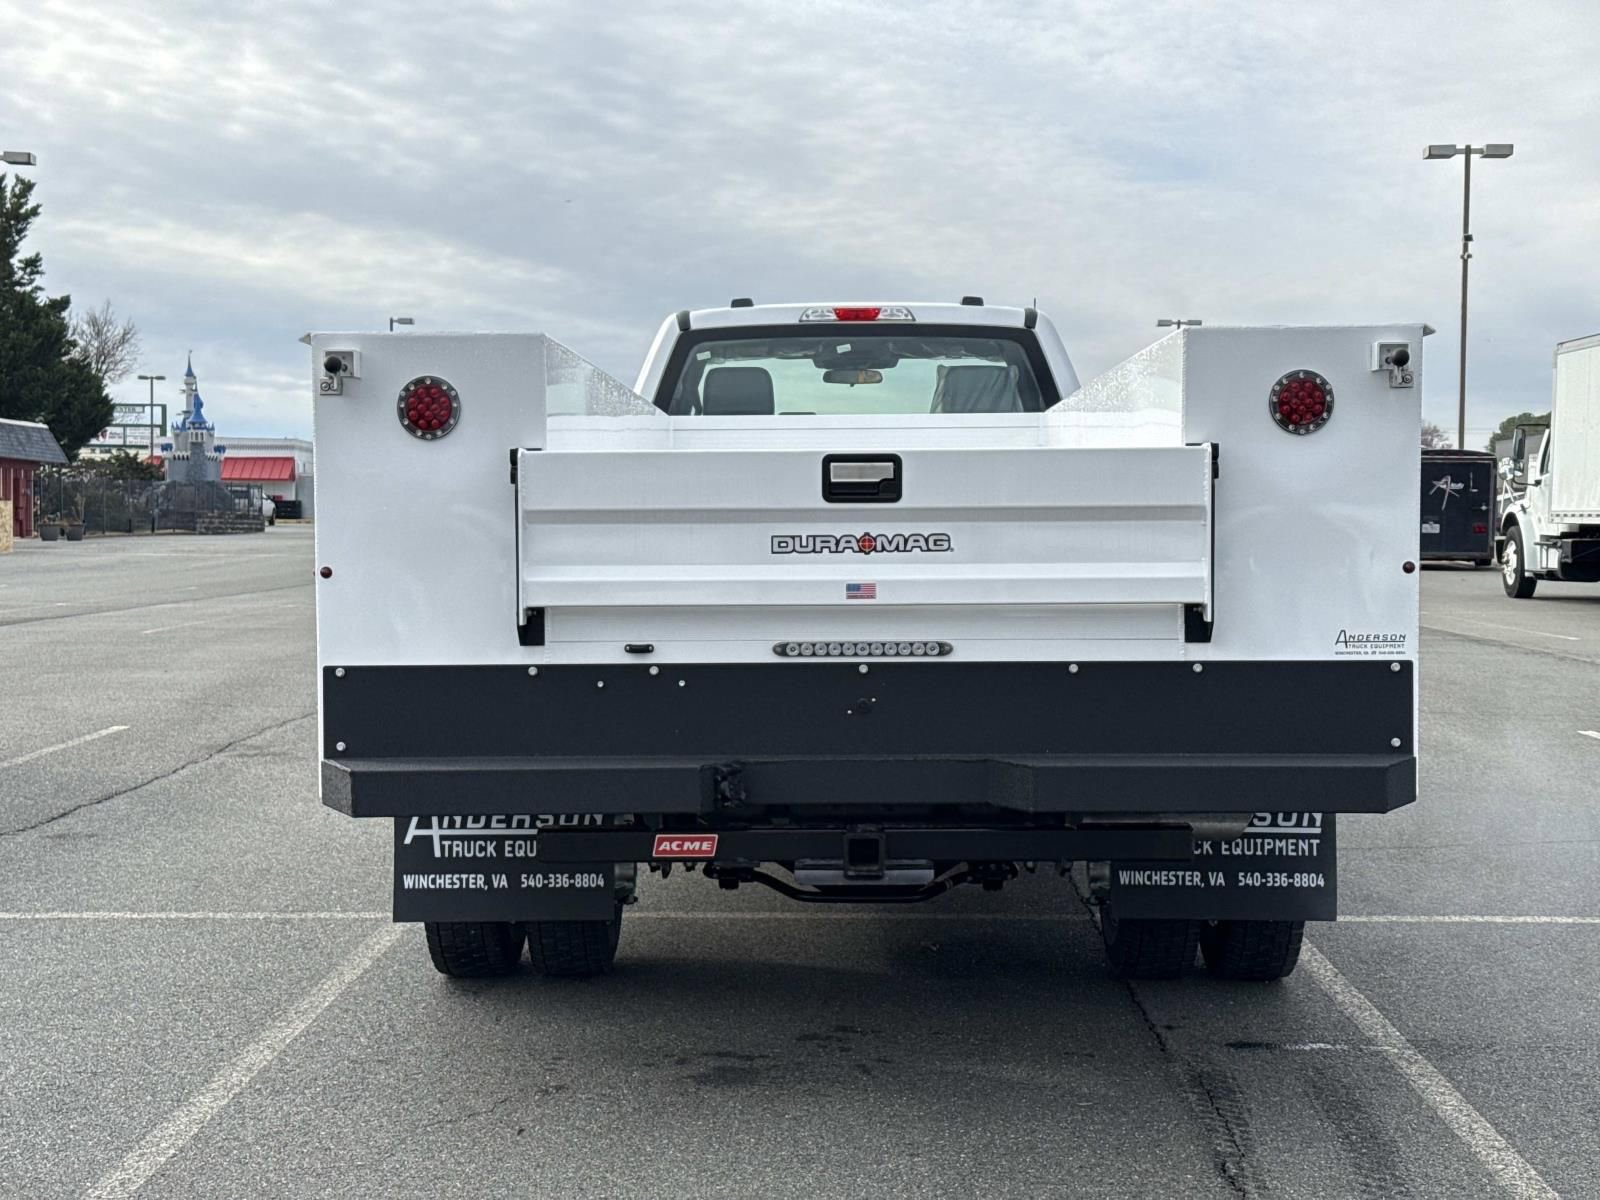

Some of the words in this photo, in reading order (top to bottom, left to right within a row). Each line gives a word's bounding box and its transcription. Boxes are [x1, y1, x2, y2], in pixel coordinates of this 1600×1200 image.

[1335, 629, 1406, 648] ANDERSON
[442, 840, 497, 858] TRUCK
[658, 840, 713, 851] ACME
[1221, 838, 1320, 857] EQUIPMENT
[403, 873, 489, 891] WINCHESTER,
[491, 874, 509, 889] VA
[520, 873, 605, 889] 540-336-8804
[1118, 870, 1205, 888] WINCHESTER,
[1208, 871, 1226, 887] VA
[1238, 872, 1325, 888] 540-336-8804
